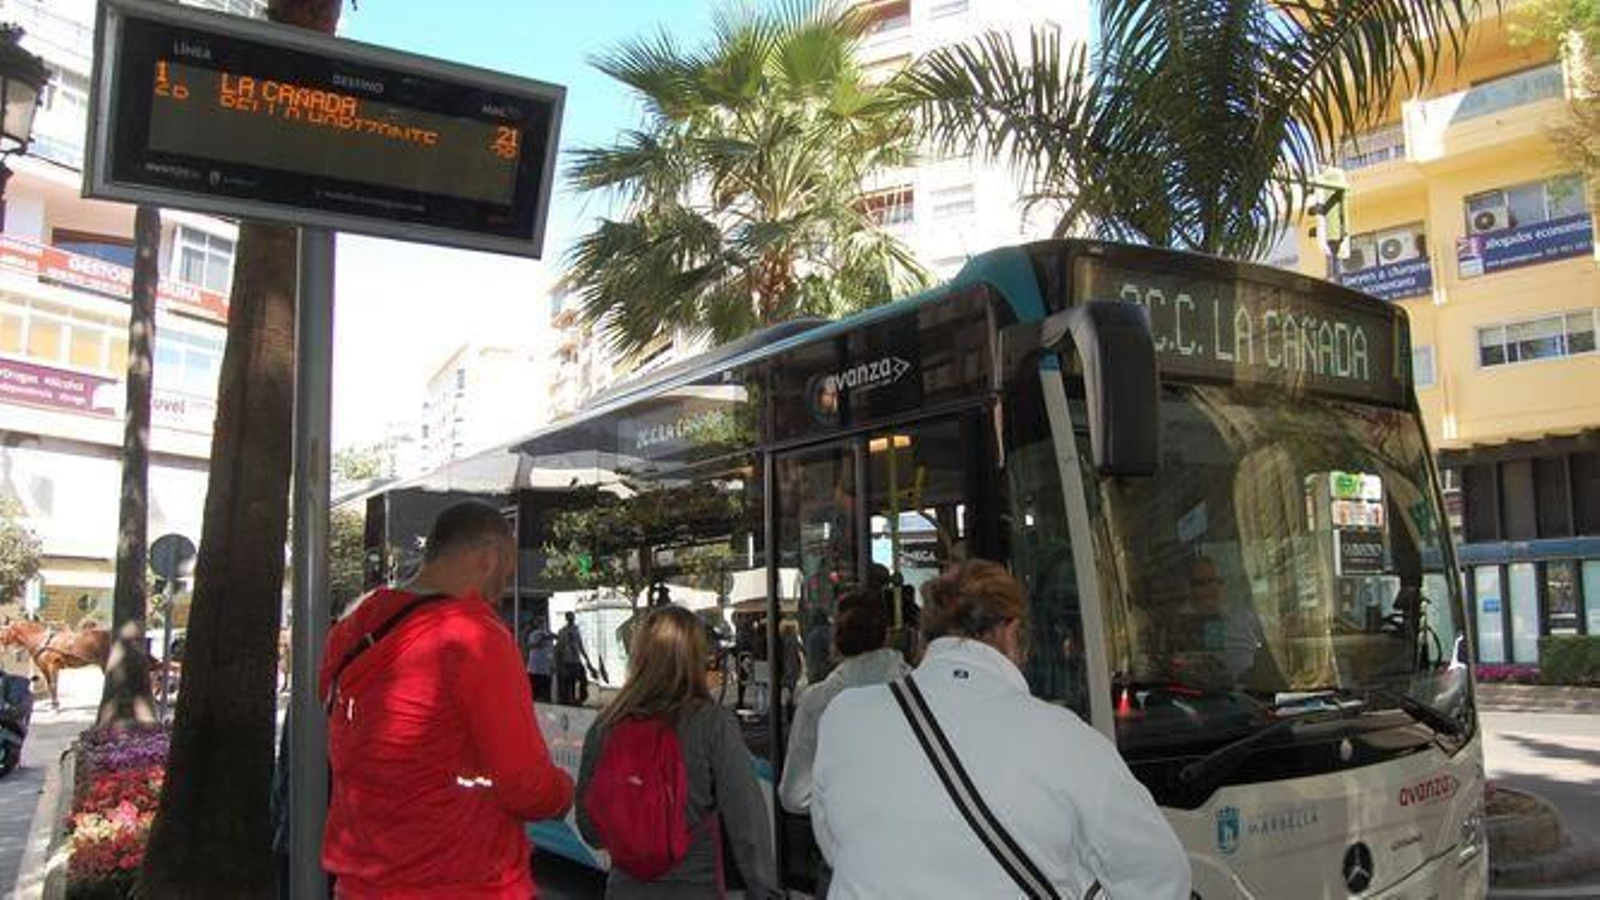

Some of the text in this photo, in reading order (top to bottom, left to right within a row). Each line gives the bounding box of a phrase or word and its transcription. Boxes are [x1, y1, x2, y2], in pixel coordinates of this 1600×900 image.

[220, 72, 255, 97] LA
[1214, 299, 1253, 364] LA
[1264, 304, 1370, 382] CAÑADA
[825, 358, 891, 393] avanza
[1399, 774, 1451, 807] avanza
